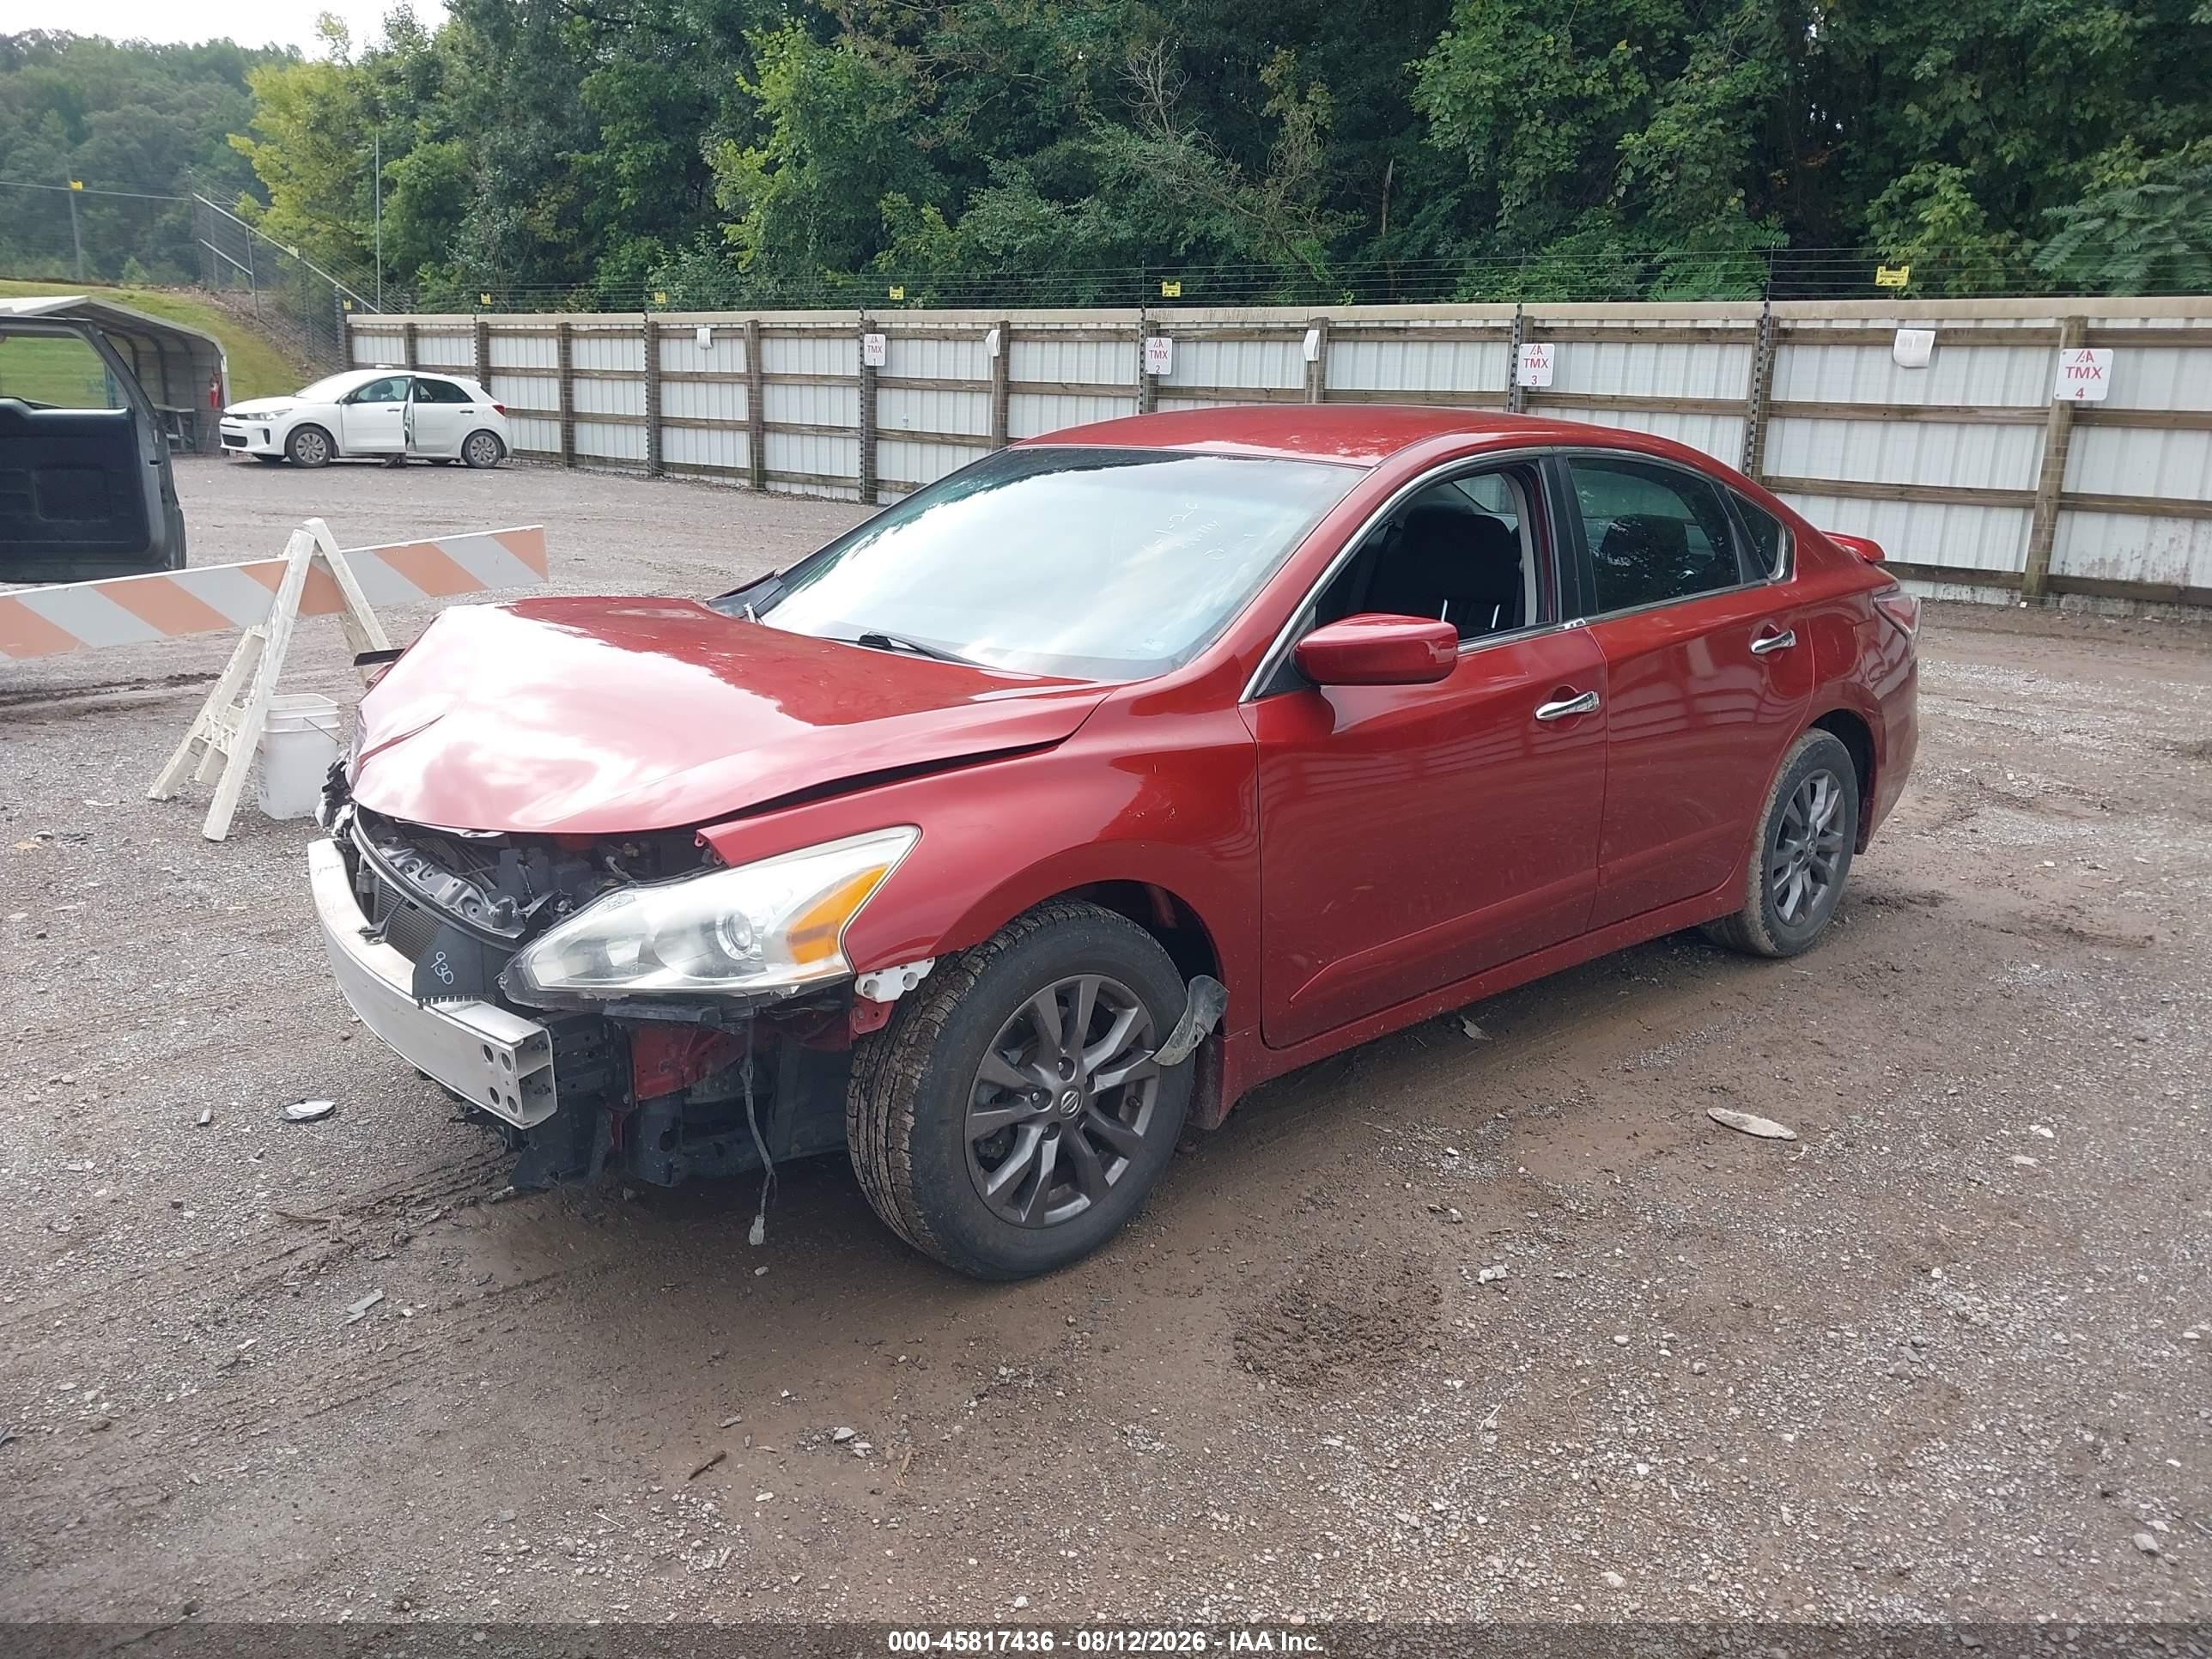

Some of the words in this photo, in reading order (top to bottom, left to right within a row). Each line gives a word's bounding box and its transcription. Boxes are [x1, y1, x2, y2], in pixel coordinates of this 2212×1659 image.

[866, 344, 883, 354] TMX
[1149, 349, 1169, 360] TMX
[1523, 357, 1549, 369] TMX
[1155, 364, 1161, 374] 2
[2065, 366, 2103, 380] TMX
[1531, 374, 1538, 385] 3
[2075, 386, 2085, 399] 4
[430, 951, 454, 985] 930
